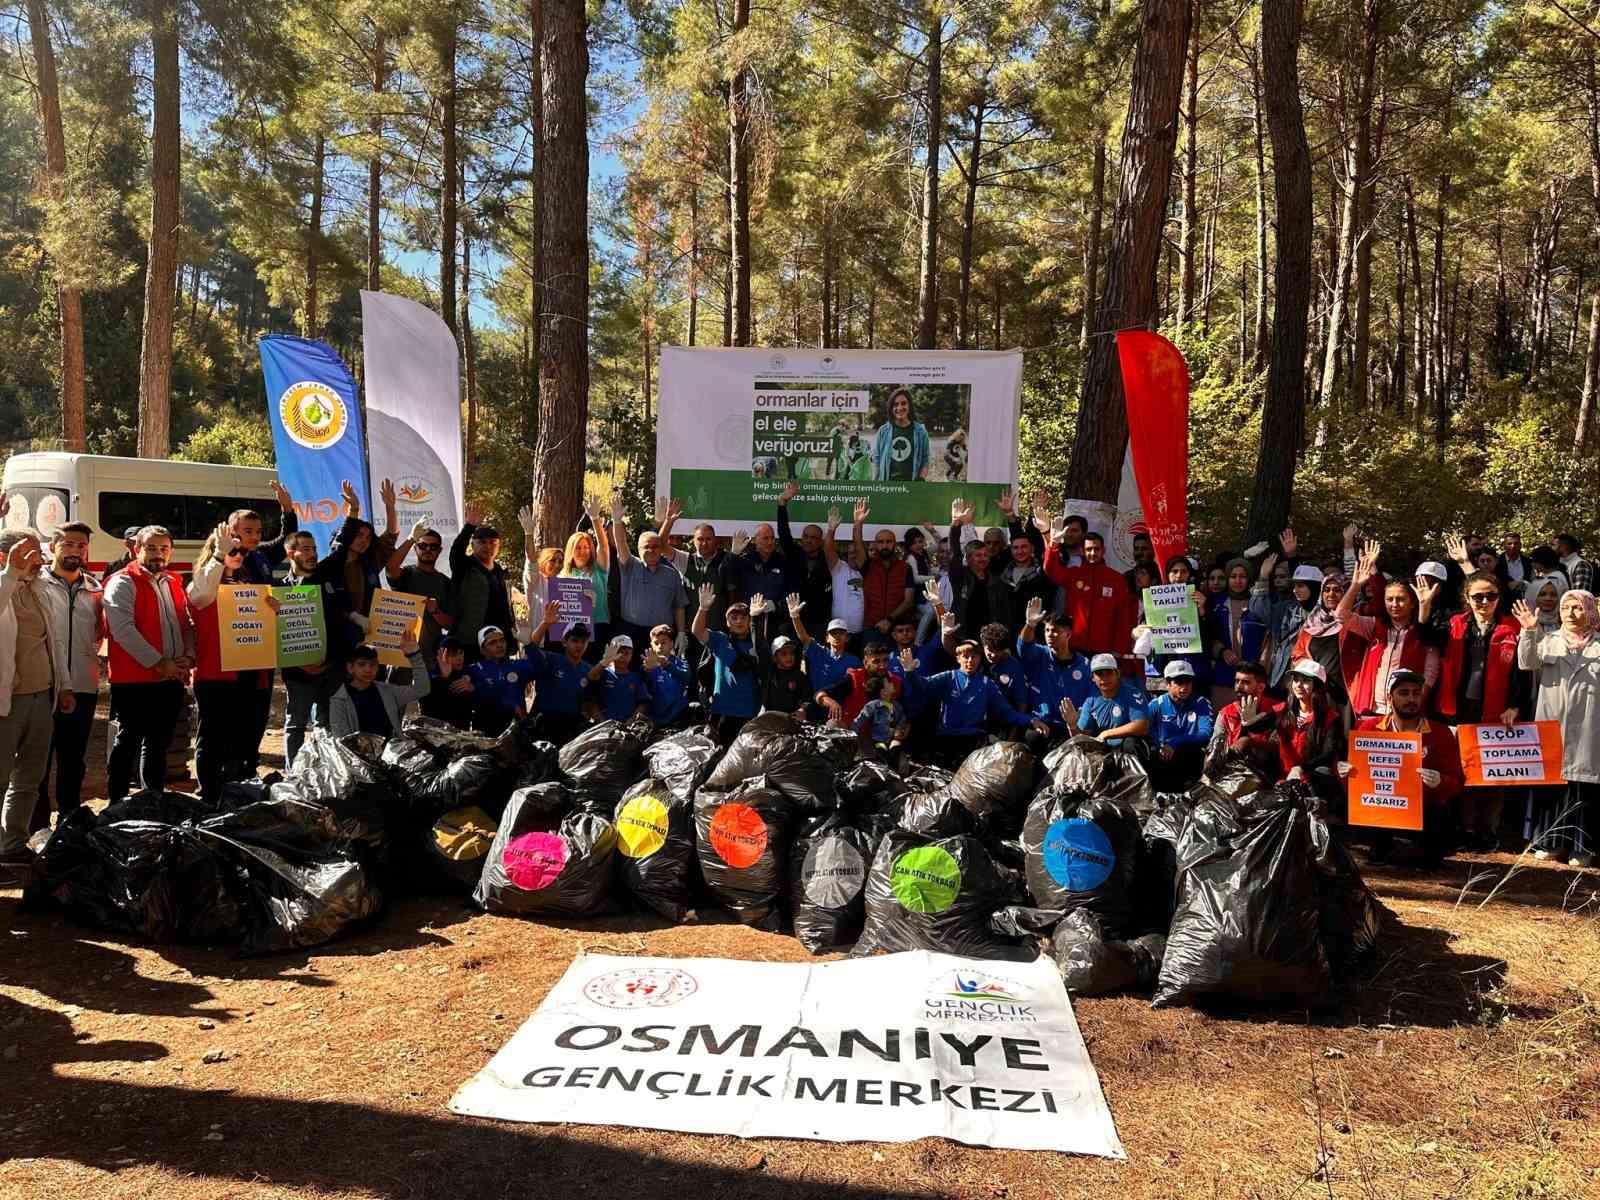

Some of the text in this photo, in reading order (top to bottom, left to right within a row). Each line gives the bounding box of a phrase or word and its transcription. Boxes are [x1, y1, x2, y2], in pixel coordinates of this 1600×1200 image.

[755, 392, 859, 413] ormanlar için
[755, 416, 798, 430] el ele
[754, 437, 834, 457] veriyoruz!
[753, 482, 770, 492] Hep
[806, 494, 828, 503] sahip
[232, 621, 263, 629] DOĞAYI
[1356, 739, 1413, 751] ORMANLAR
[1484, 748, 1541, 759] TOPLAMA
[1368, 755, 1401, 765] NEFES
[1372, 769, 1396, 778] ALIR
[1487, 767, 1530, 778] ALANI
[1375, 782, 1393, 792] BİZ
[1362, 795, 1407, 808] YAŞARIZ
[911, 870, 927, 880] ATIK
[554, 1023, 1050, 1072] OSMANİYE
[521, 1066, 1058, 1114] GENÇLİK MERKEZİ
